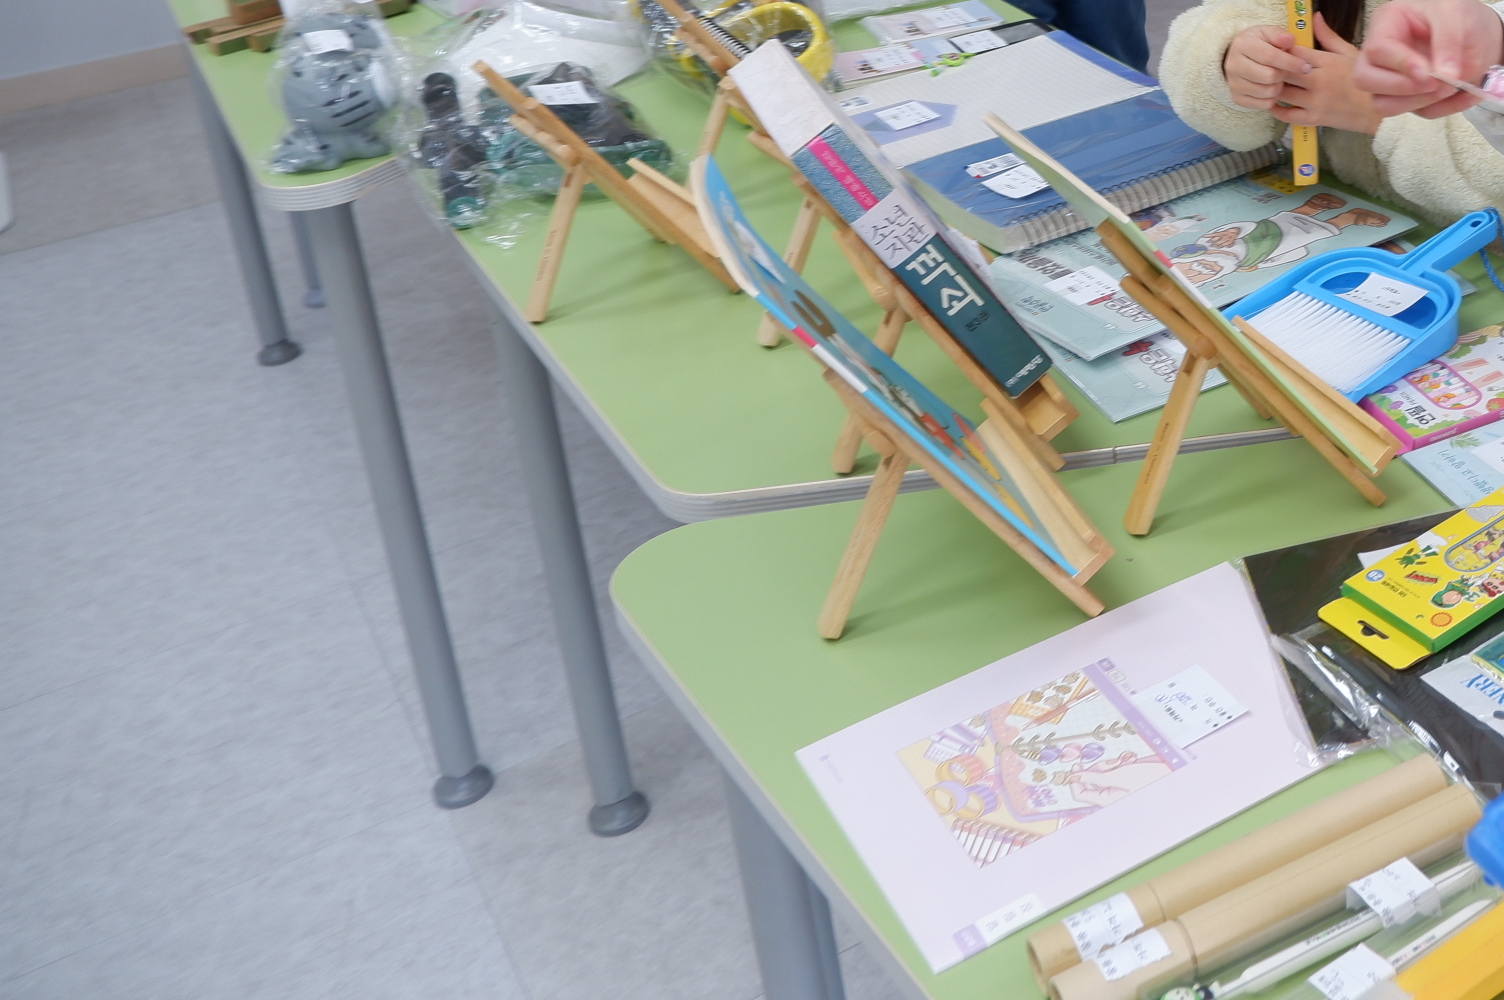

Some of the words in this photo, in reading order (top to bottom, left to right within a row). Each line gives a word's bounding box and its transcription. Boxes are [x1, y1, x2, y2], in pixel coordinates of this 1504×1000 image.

[872, 204, 912, 245] 소년
[885, 222, 928, 257] 지관
[1404, 404, 1436, 427] 연필
[1436, 448, 1466, 471] 말하기
[1366, 569, 1383, 582] 20
